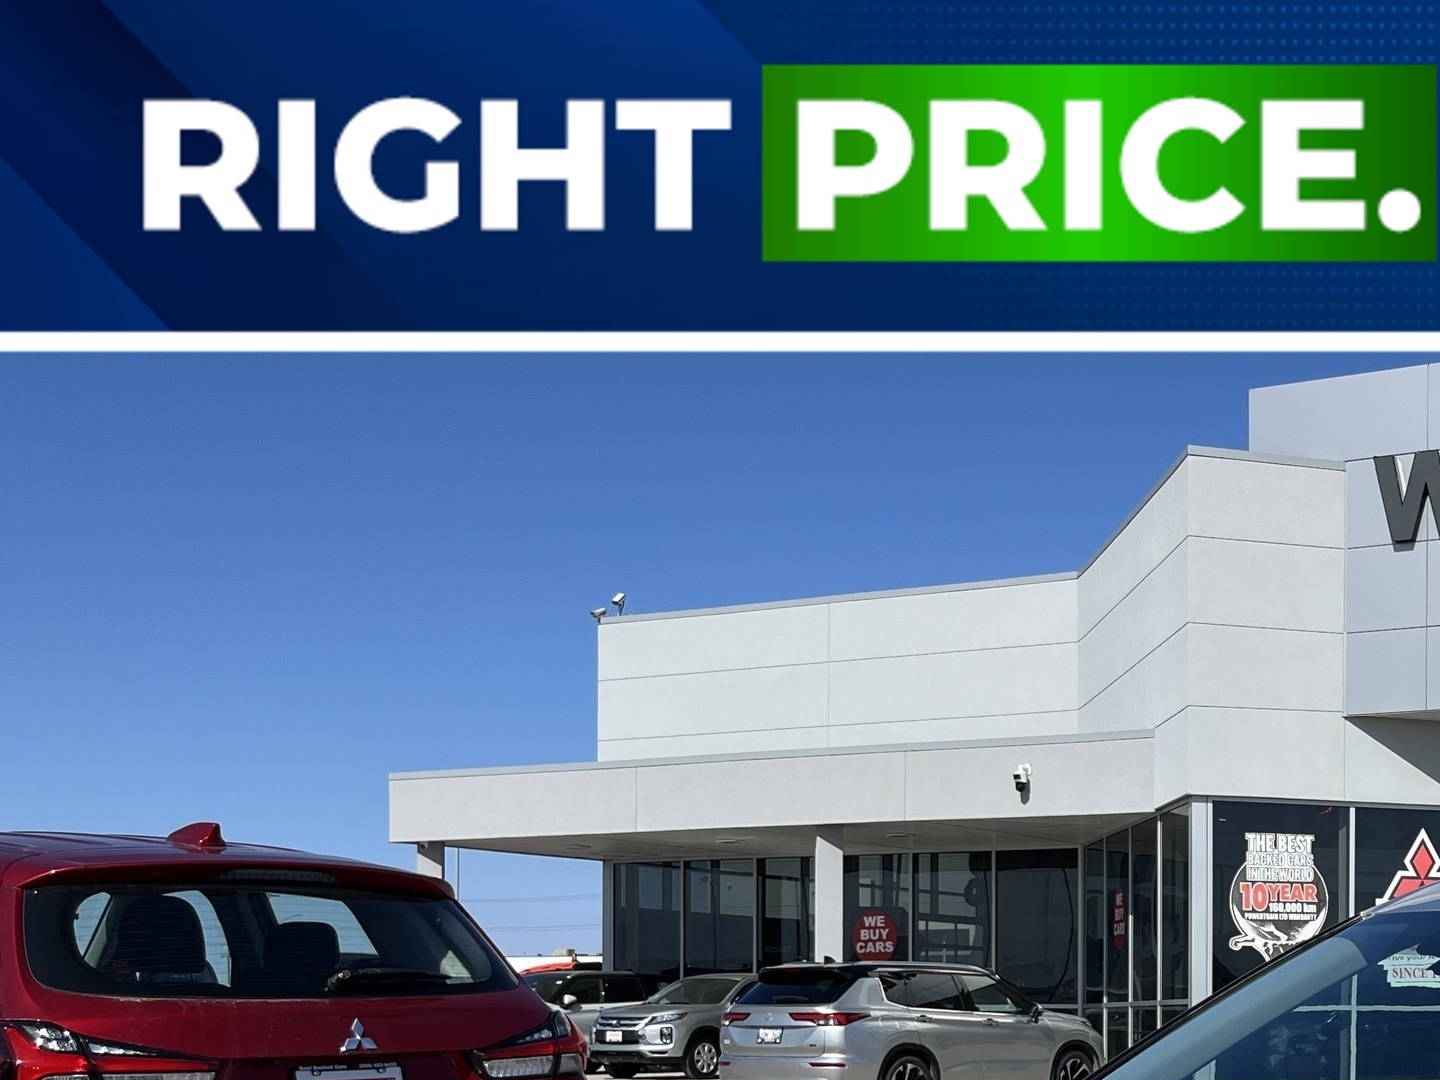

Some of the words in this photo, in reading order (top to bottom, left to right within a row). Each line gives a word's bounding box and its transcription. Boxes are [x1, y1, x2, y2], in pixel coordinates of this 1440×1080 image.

[1246, 833, 1275, 852] THE
[1277, 834, 1314, 853] BEST
[1247, 853, 1285, 866] BACKED
[1287, 854, 1314, 867] CARS
[1247, 867, 1257, 879] IN
[1257, 867, 1278, 880] THE
[1279, 867, 1314, 880] WORLD
[1240, 882, 1269, 911] 10
[1267, 883, 1318, 902] YEAR
[1269, 903, 1302, 913] 160,000
[1303, 903, 1317, 912] km
[863, 916, 886, 927] WE
[860, 929, 889, 940] BUY
[856, 941, 894, 953] CARS
[1392, 967, 1428, 979] SINCE
